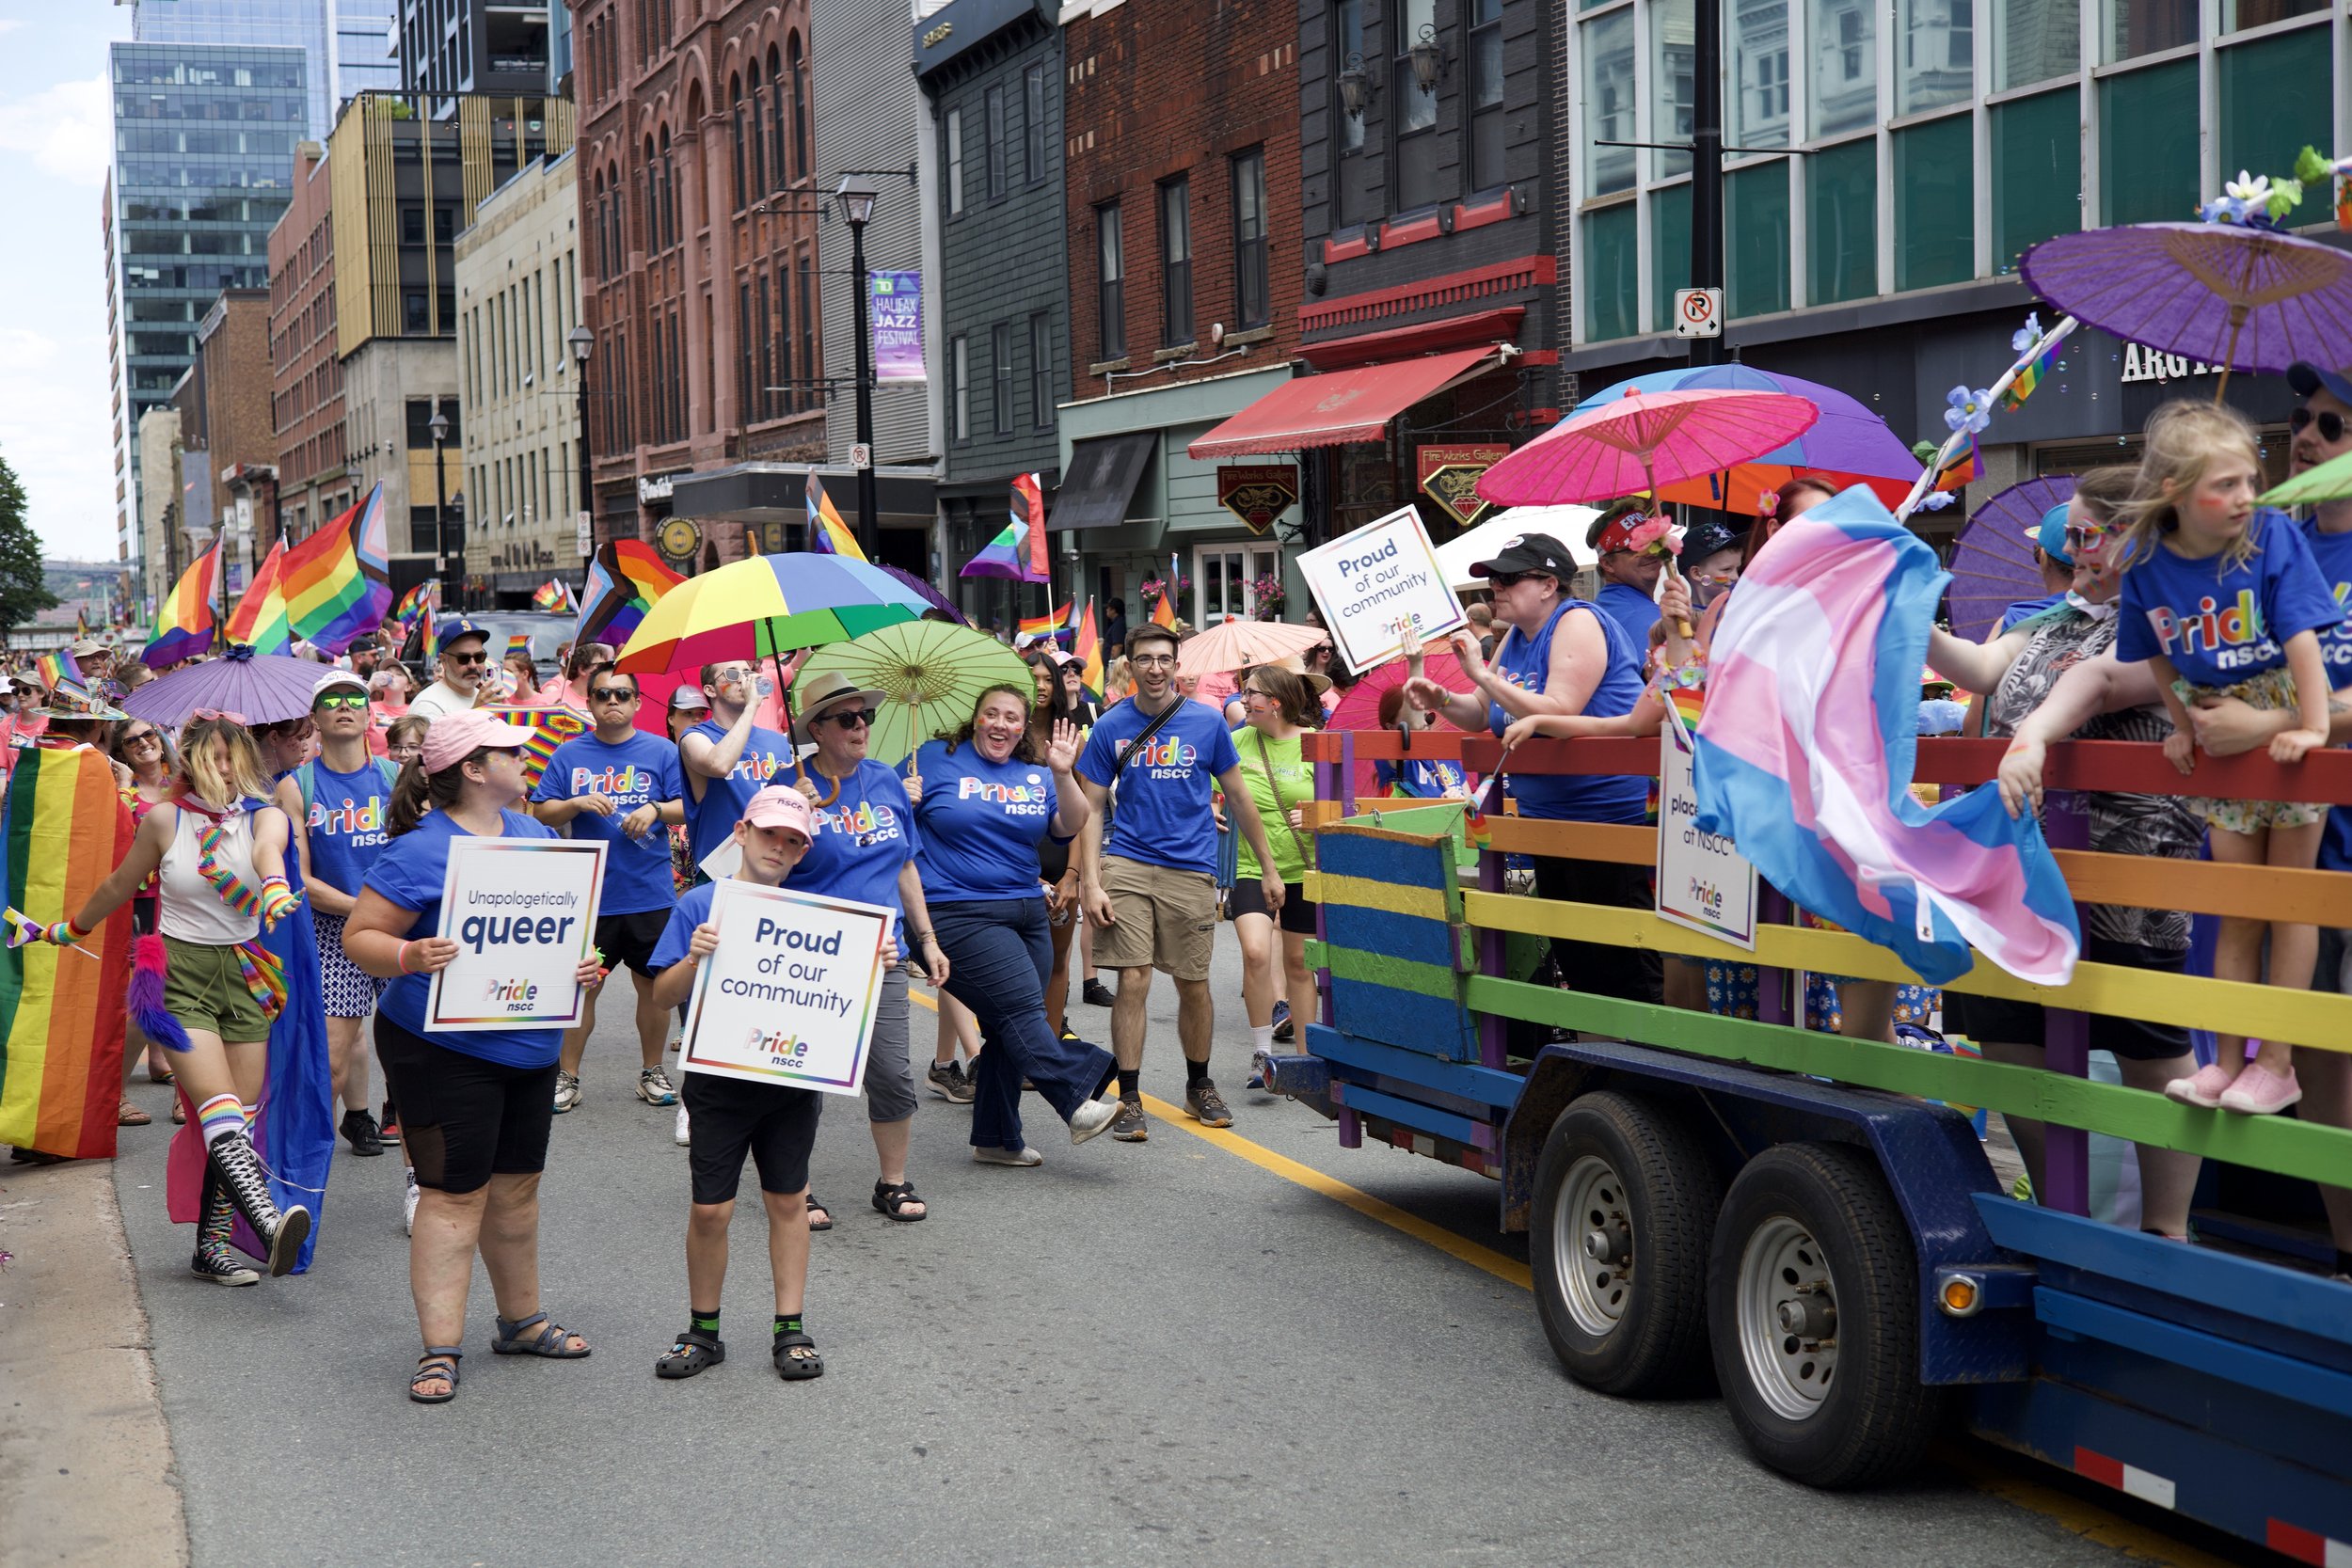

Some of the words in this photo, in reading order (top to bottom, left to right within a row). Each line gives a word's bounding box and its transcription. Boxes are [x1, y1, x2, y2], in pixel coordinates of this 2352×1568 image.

[876, 297, 917, 313] HALIFAX
[875, 314, 917, 328] JAZZ
[877, 330, 920, 345] FESTIVAL
[1443, 451, 1470, 461] Works
[1473, 449, 1507, 462] Gallery
[1338, 537, 1398, 578] Proud
[1355, 574, 1371, 593] of
[1375, 564, 1400, 583] our
[1343, 571, 1427, 617] community
[1378, 611, 1422, 641] Pride
[571, 765, 652, 796] Pride
[1151, 768, 1192, 780] nscc
[611, 793, 649, 805] nscc
[959, 776, 1046, 803] Pride
[777, 798, 803, 812] nscc
[1005, 803, 1046, 816] nscc
[809, 800, 896, 836] Pride
[1683, 829, 1695, 845] at
[468, 889, 579, 910] Unapologetically
[1688, 876, 1723, 909] Pride
[1703, 906, 1722, 920] nscc
[461, 914, 576, 955] queer
[755, 917, 843, 956] Proud
[757, 954, 785, 975] of
[789, 962, 828, 983] our
[482, 978, 538, 1002] Pride
[721, 977, 852, 1018] community
[506, 1002, 534, 1012] nscc
[743, 1027, 809, 1057] Pride
[771, 1055, 803, 1069] nscc
